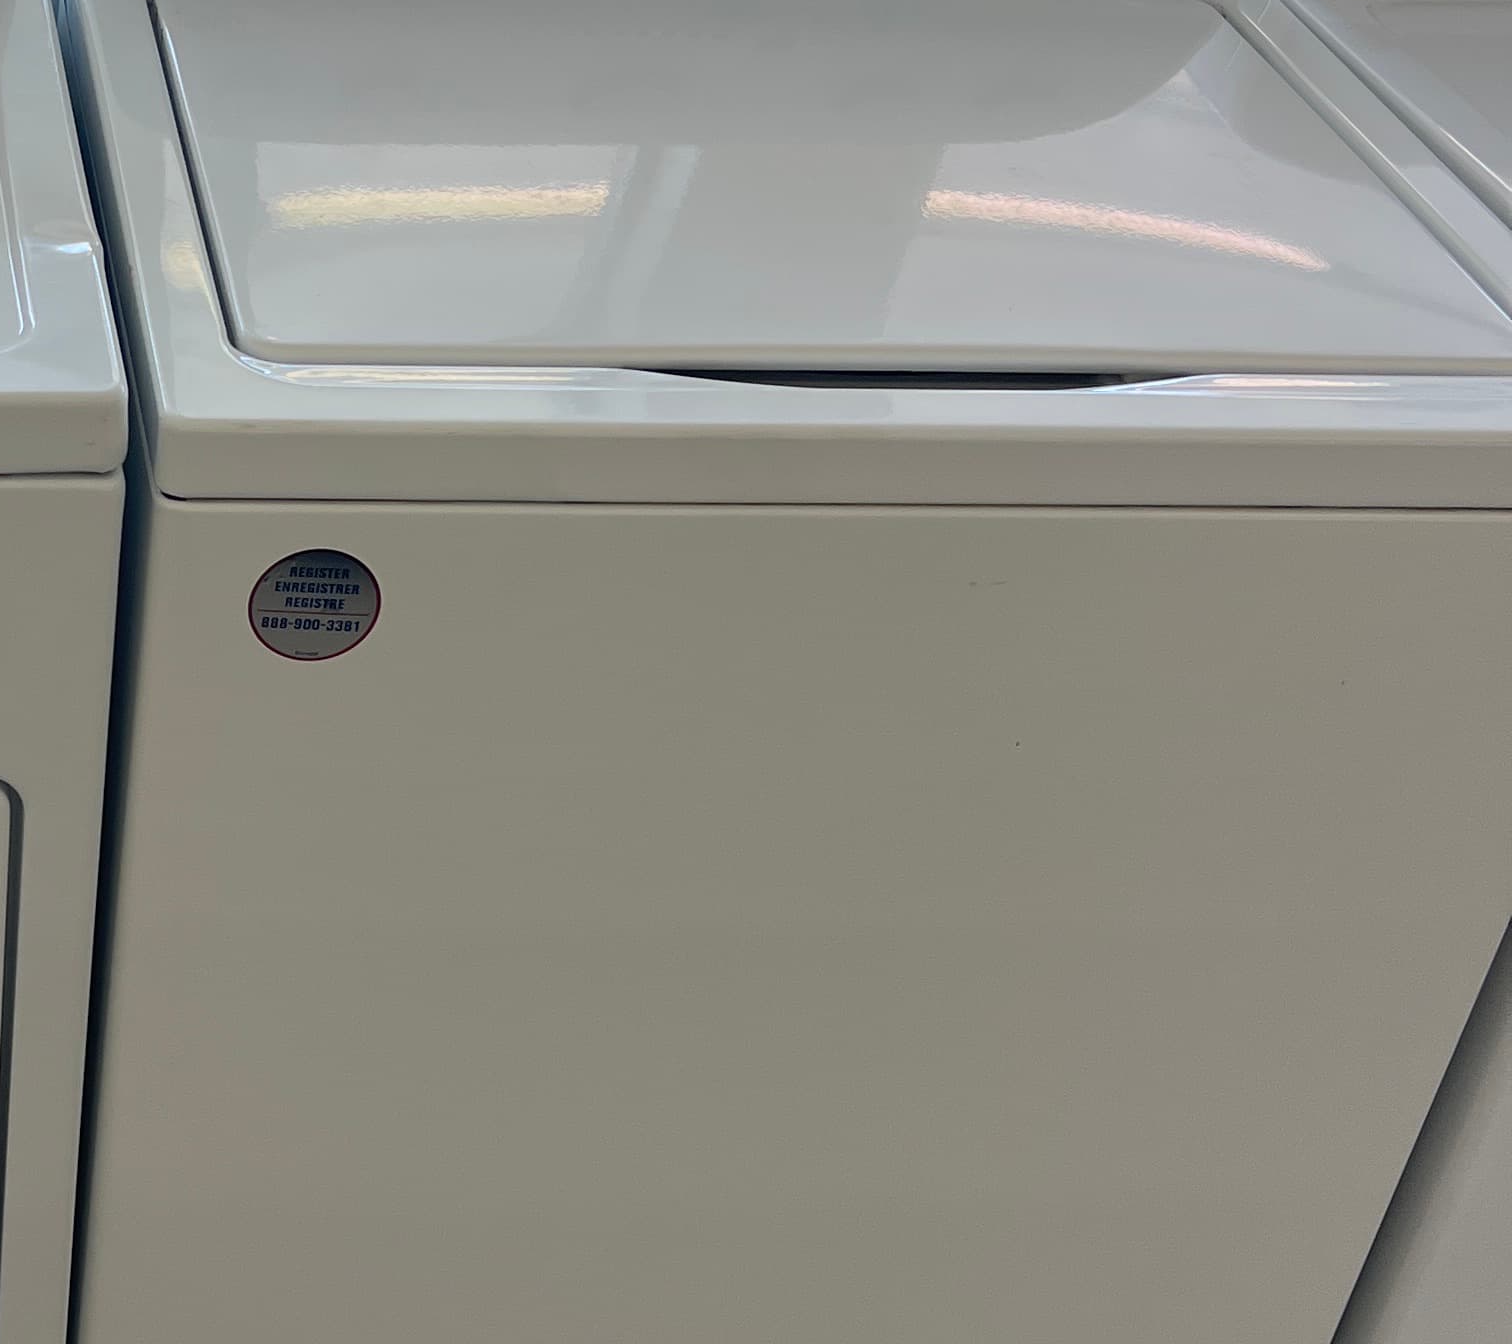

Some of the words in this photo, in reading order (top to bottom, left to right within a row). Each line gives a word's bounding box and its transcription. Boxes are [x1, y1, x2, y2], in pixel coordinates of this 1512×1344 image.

[289, 566, 350, 579] REGISTER
[274, 581, 360, 595] ENREGISTRER
[284, 597, 345, 610] REGISTRE
